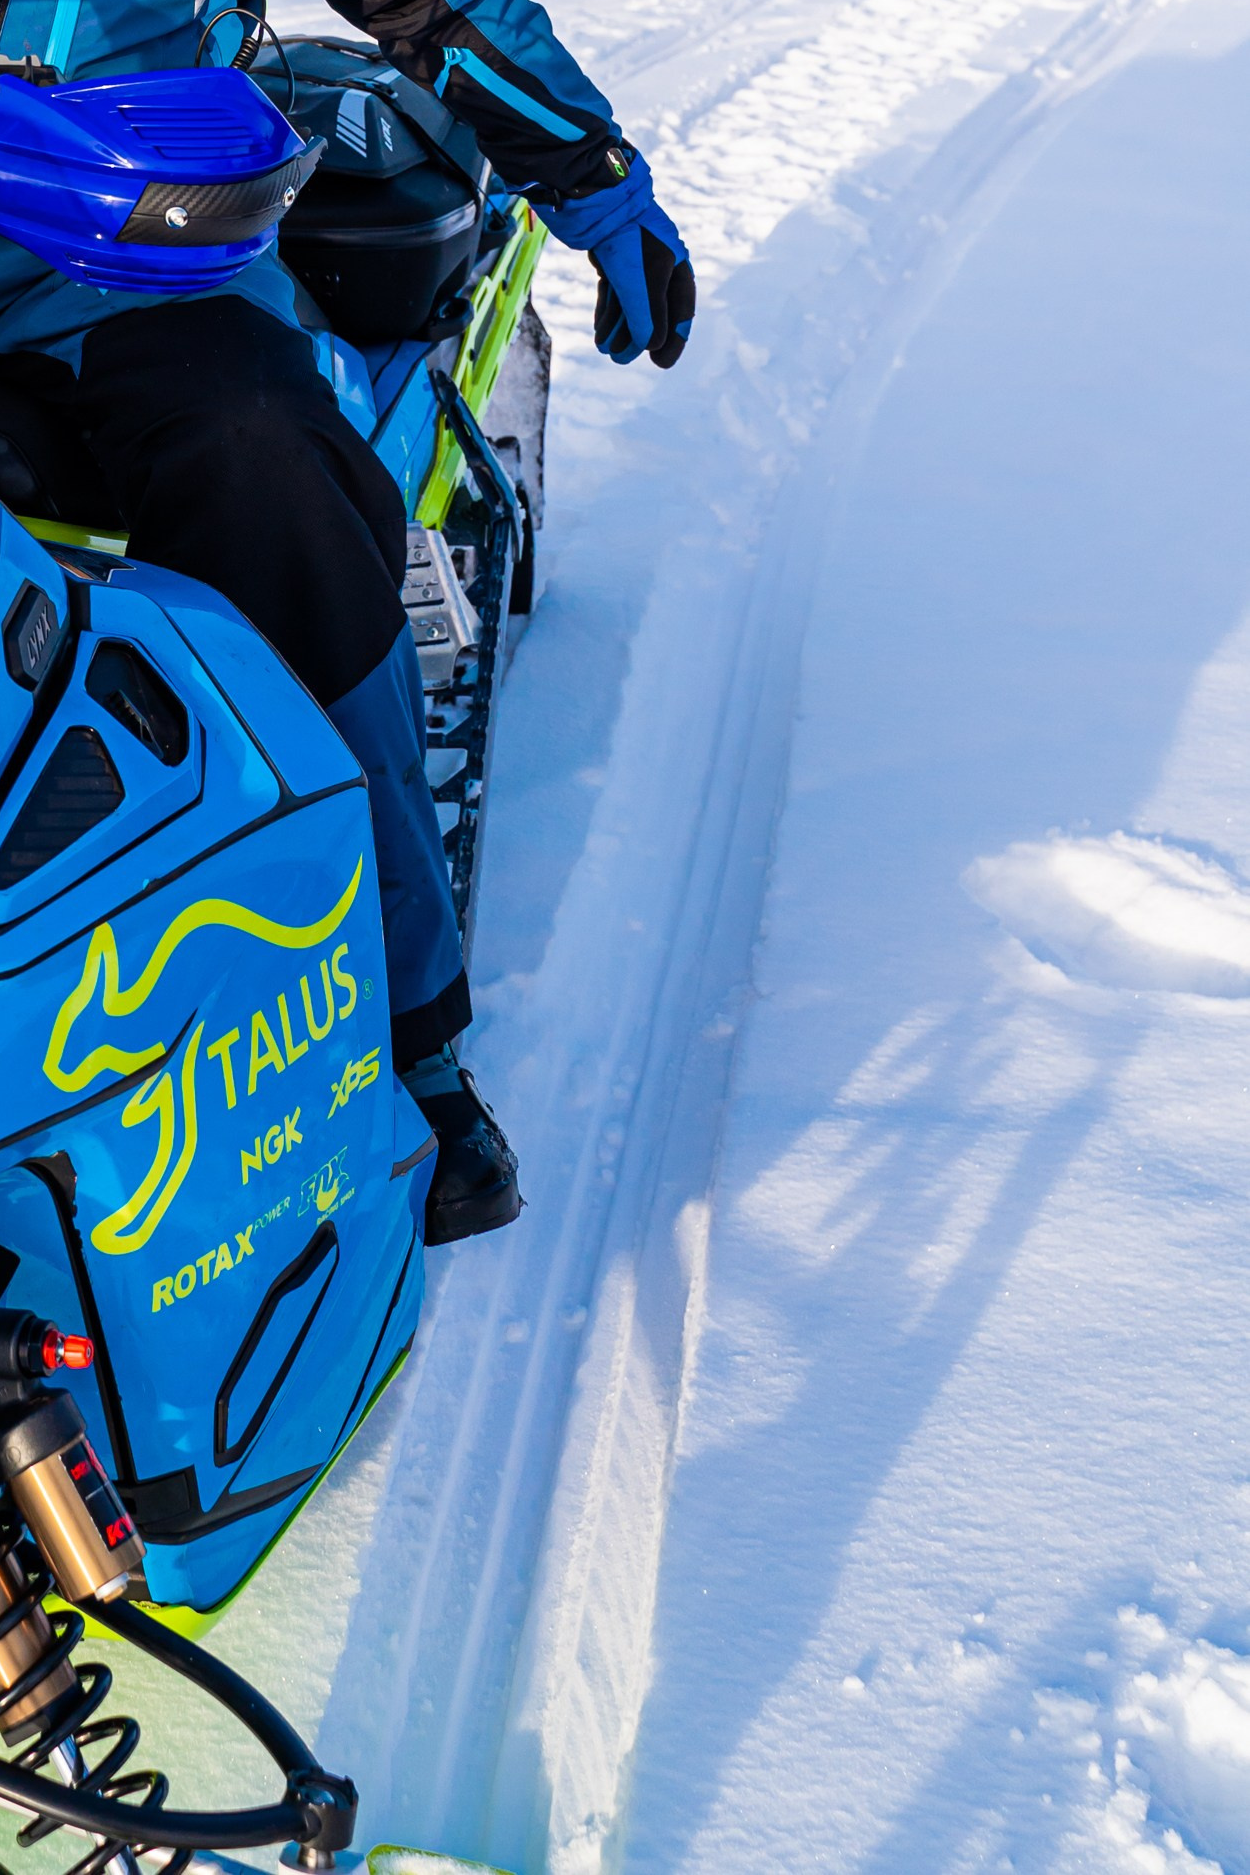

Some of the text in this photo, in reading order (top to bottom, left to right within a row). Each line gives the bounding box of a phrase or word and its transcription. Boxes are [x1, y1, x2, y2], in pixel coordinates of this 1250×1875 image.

[27, 605, 51, 669] LYNX
[207, 943, 357, 1110] TALUS
[327, 1046, 381, 1120] XPS
[240, 1106, 303, 1186] NGK
[152, 1196, 291, 1313] ROTAX POWER
